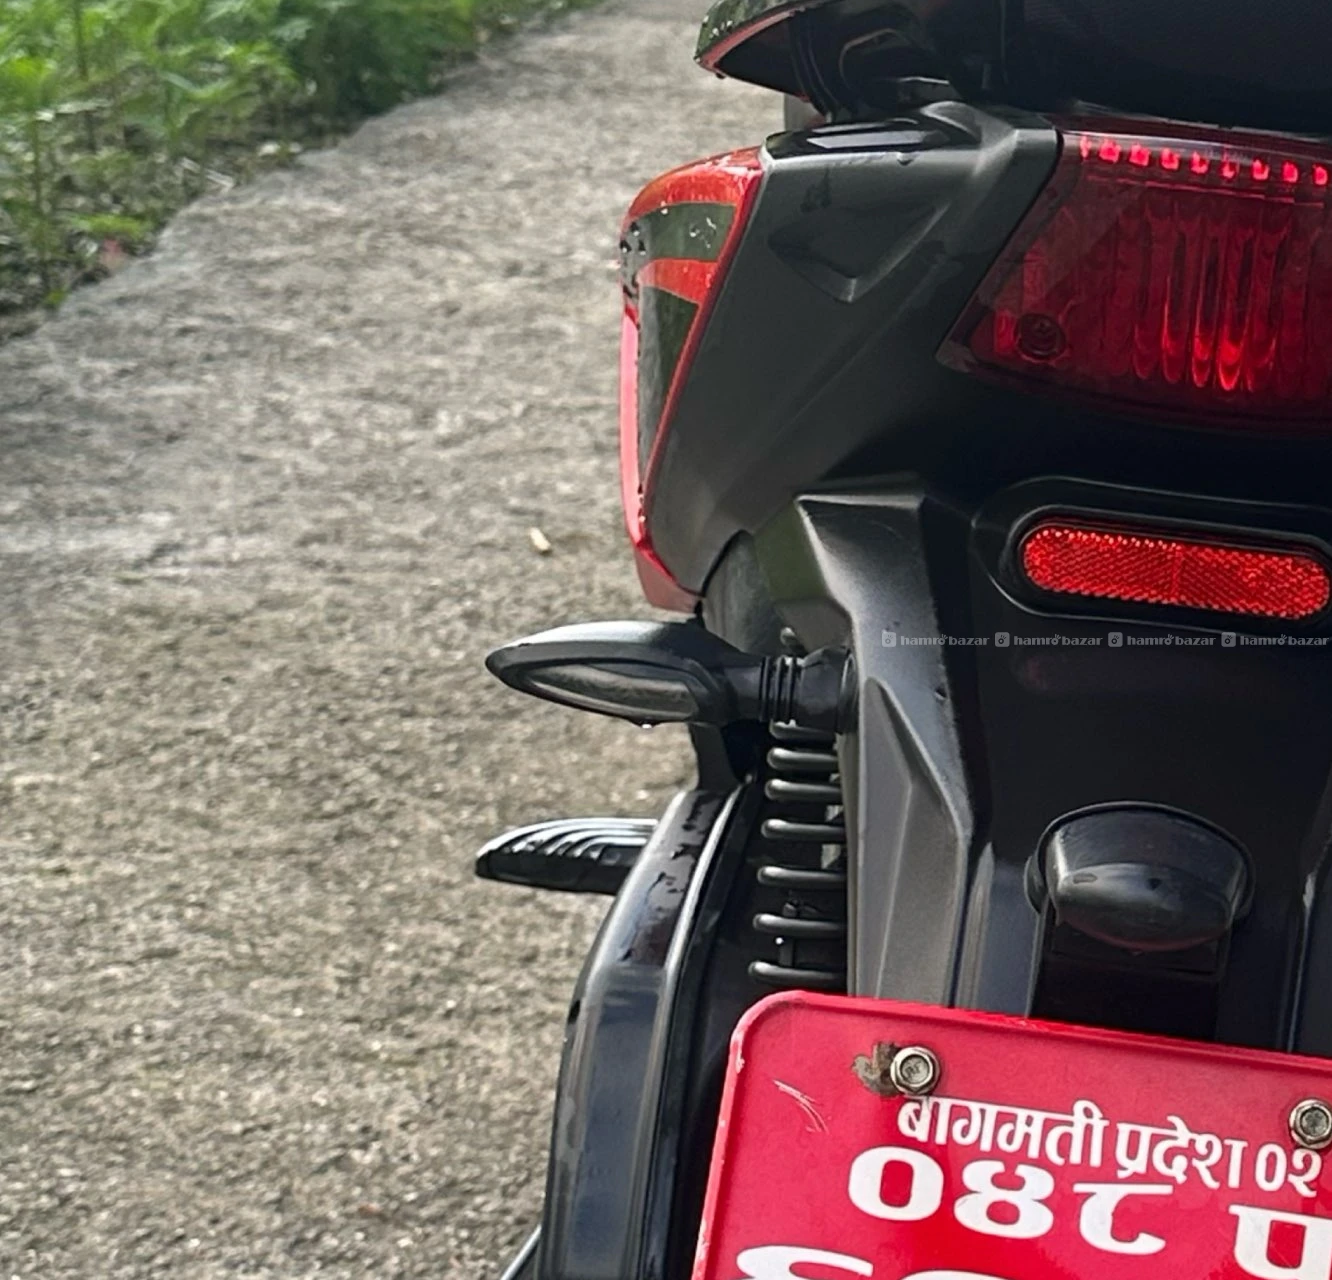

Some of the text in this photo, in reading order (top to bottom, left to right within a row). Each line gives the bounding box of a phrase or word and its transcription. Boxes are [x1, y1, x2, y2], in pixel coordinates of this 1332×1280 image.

[897, 1094, 1323, 1197] बागमती प्रदेश ०२
[848, 1146, 1174, 1255] ०४८
